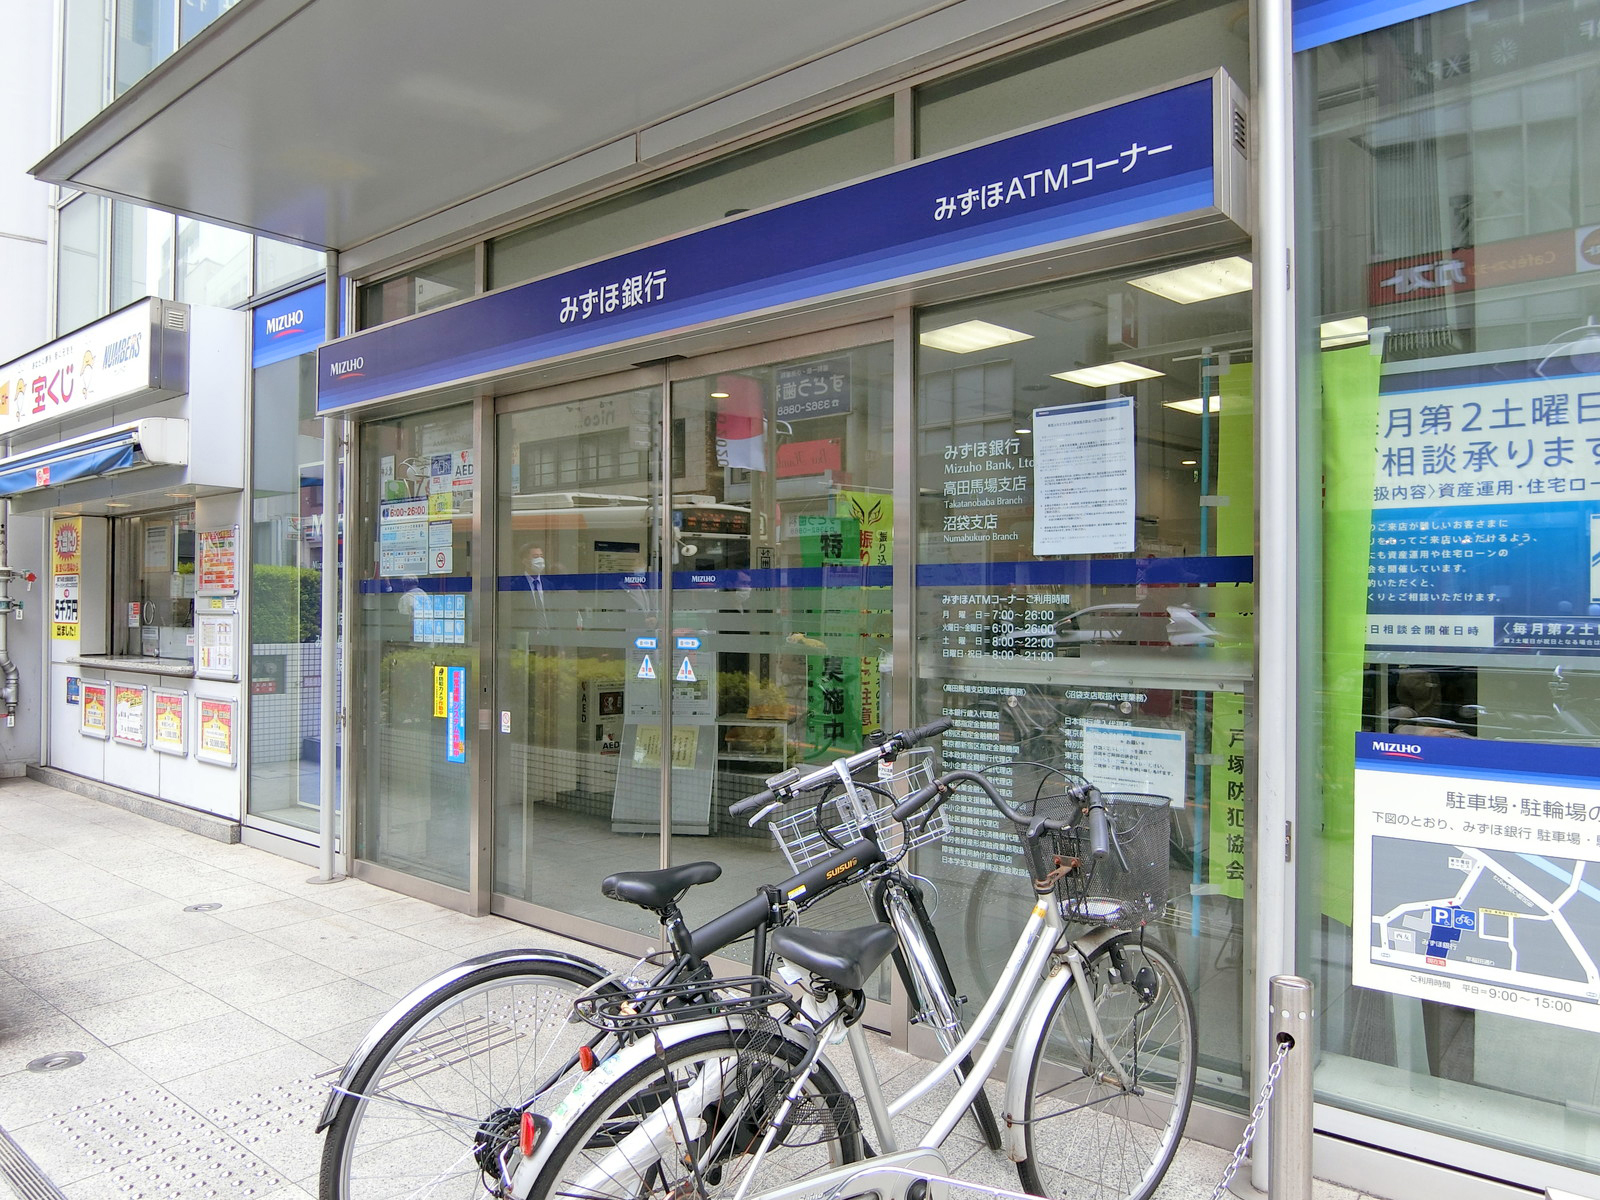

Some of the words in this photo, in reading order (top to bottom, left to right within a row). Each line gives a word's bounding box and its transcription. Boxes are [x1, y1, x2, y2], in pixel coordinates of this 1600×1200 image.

[933, 142, 1172, 221] みずほATMコーナー
[559, 269, 667, 323] みずほ銀行
[266, 310, 303, 335] MIZUHO
[103, 331, 142, 370] NUMBERS
[330, 357, 364, 376] MIZUHO
[32, 364, 74, 414] 宝くじ
[1376, 391, 1600, 439] 月第2土曜日
[944, 438, 1020, 460] みずほ銀行
[1375, 436, 1600, 477] 相談承りま
[455, 464, 473, 477] AED
[944, 461, 982, 474] Mizuho
[985, 458, 1015, 471] Bank,
[943, 476, 1027, 496] 高田馬場支店
[944, 497, 995, 509] Takatanobaba
[997, 496, 1023, 506] Branch
[943, 513, 998, 531] 沼袋支店
[943, 533, 991, 543] Numabukuro
[992, 531, 1019, 541] Branch
[624, 576, 646, 584] MIZUHO
[691, 575, 716, 583] MIZUHO
[942, 594, 1070, 605] みずほATMコーナーご利用時間
[55, 600, 78, 621] 5千万円
[1365, 624, 1479, 636] 日相談会開催日時
[1503, 622, 1600, 636] 〈毎月第2土
[602, 741, 620, 750] AED
[1372, 741, 1422, 754] MIZUHO
[1537, 828, 1600, 847] 駐車場・
[1435, 910, 1449, 924] P
[1421, 939, 1458, 951] みずほ銀行
[1410, 974, 1451, 988] ご利用時間
